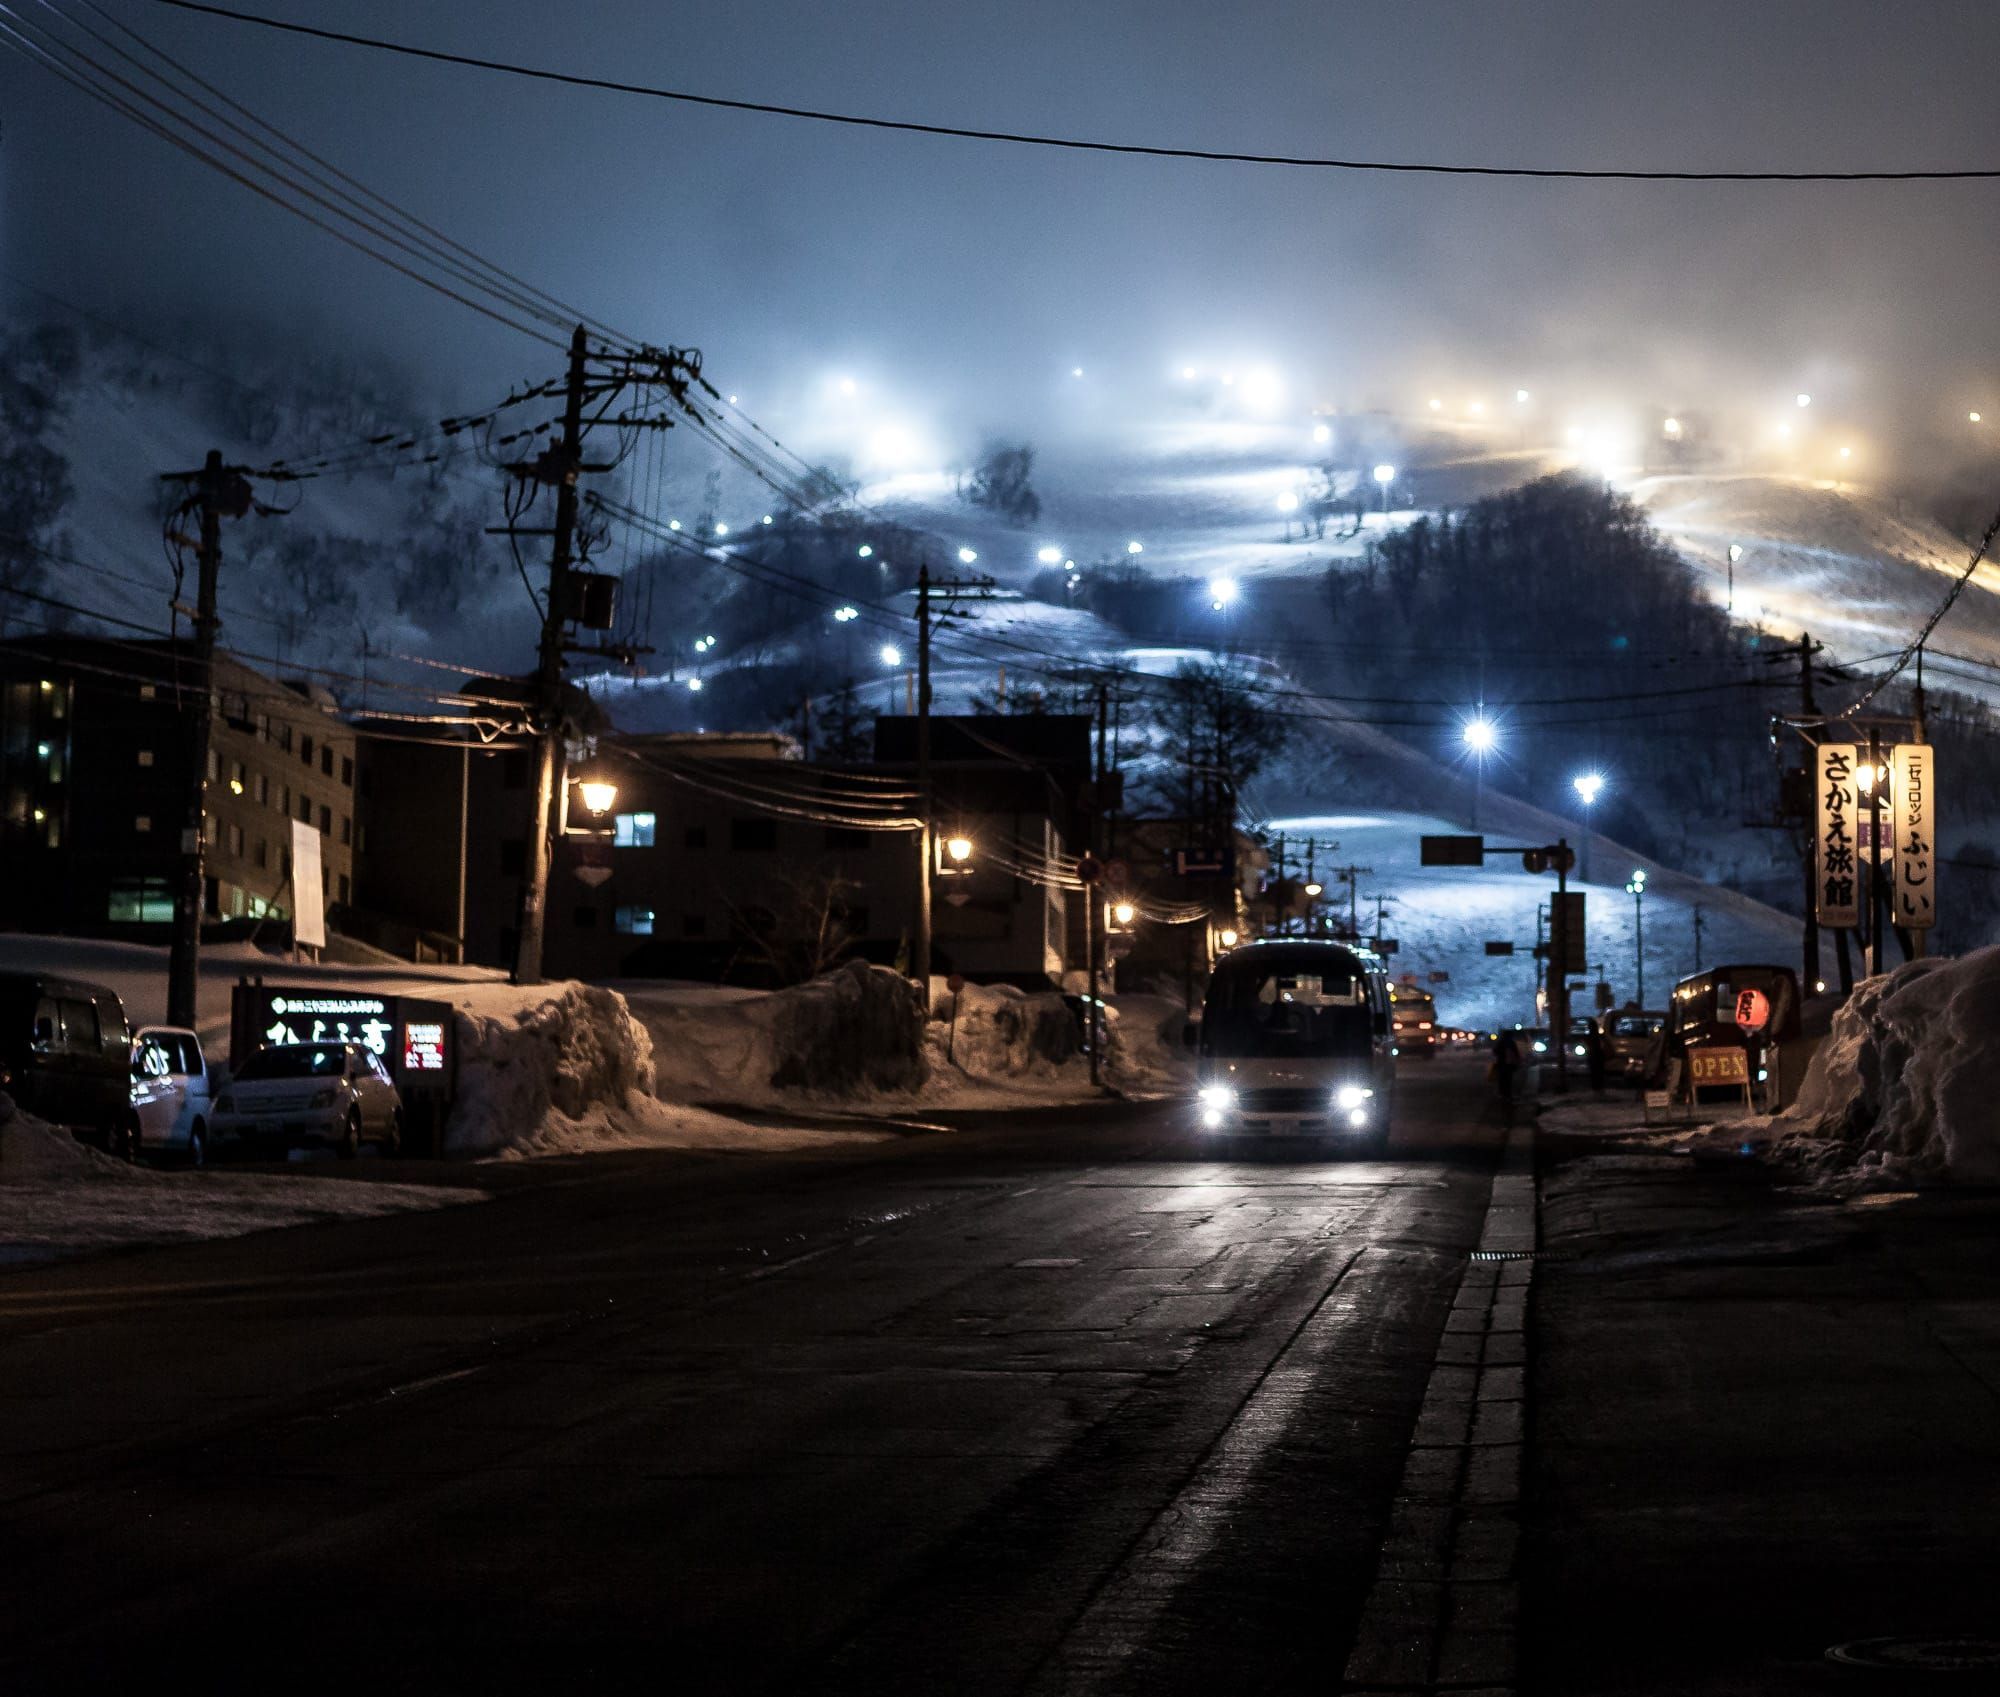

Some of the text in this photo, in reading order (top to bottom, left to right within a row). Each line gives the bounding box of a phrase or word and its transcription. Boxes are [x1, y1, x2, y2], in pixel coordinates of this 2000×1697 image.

[1824, 752, 1854, 908] さかえ旅館
[1902, 832, 1930, 915] ふじい
[1692, 1055, 1745, 1078] OPEN
